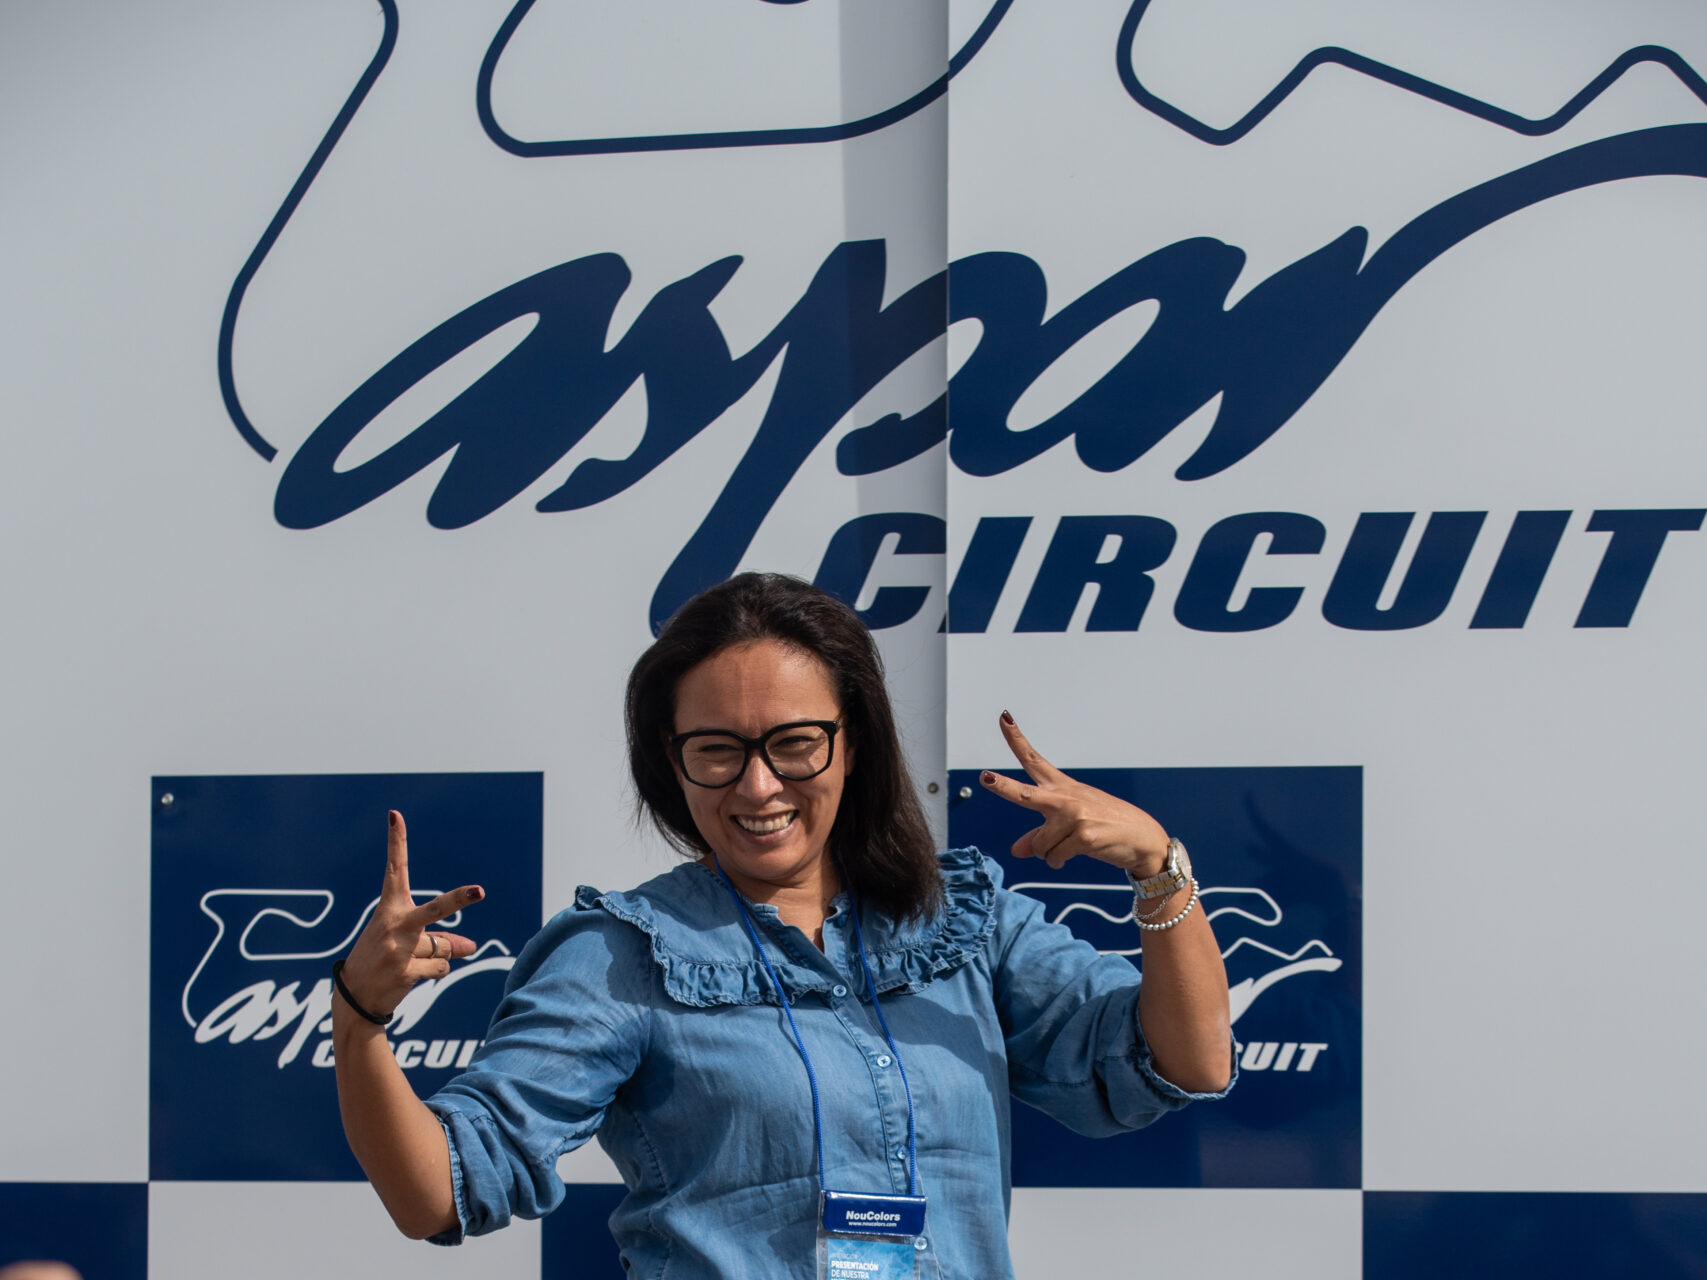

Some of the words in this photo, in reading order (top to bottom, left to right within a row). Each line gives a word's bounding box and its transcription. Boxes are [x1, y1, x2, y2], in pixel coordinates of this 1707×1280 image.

[815, 508, 1707, 633] CIRCUIT
[845, 1210, 901, 1221] NouColors
[831, 1260, 879, 1271] PRESENTACIÓN
[831, 1269, 841, 1277] DE
[841, 1270, 870, 1279] NUESTRA
